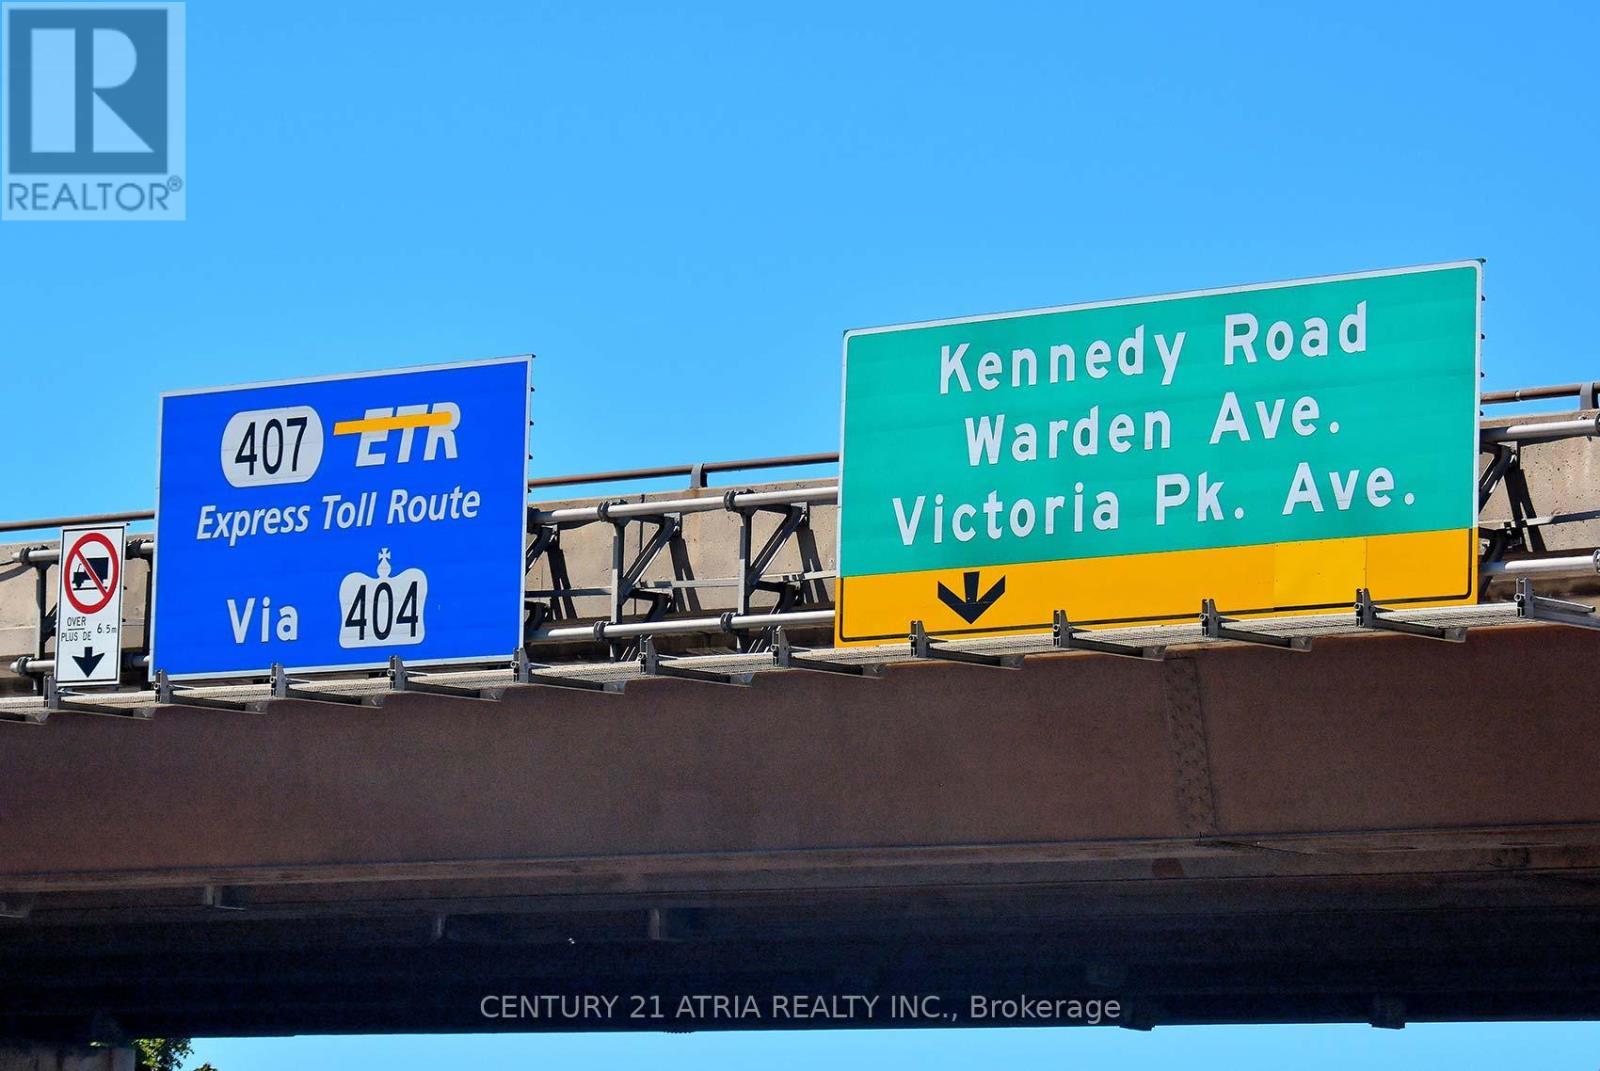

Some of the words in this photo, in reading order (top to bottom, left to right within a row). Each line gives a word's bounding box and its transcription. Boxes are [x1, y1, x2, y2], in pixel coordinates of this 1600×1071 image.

[939, 325, 1186, 395] Kennedy
[1223, 301, 1367, 366] Road
[234, 416, 308, 476] 407
[355, 401, 461, 467] ETR
[964, 405, 1171, 466] Warden
[1209, 392, 1340, 445] Ave.
[196, 504, 311, 547] Express
[322, 491, 377, 530] Toll
[386, 485, 481, 525] Route
[892, 482, 1119, 546] Victoria
[1155, 473, 1244, 526] Pk.
[1281, 462, 1415, 516] Ave.
[61, 632, 78, 641] PLUS
[82, 631, 92, 641] DE
[67, 616, 86, 626] OVER
[226, 596, 299, 644] Via
[345, 581, 419, 641] 404
